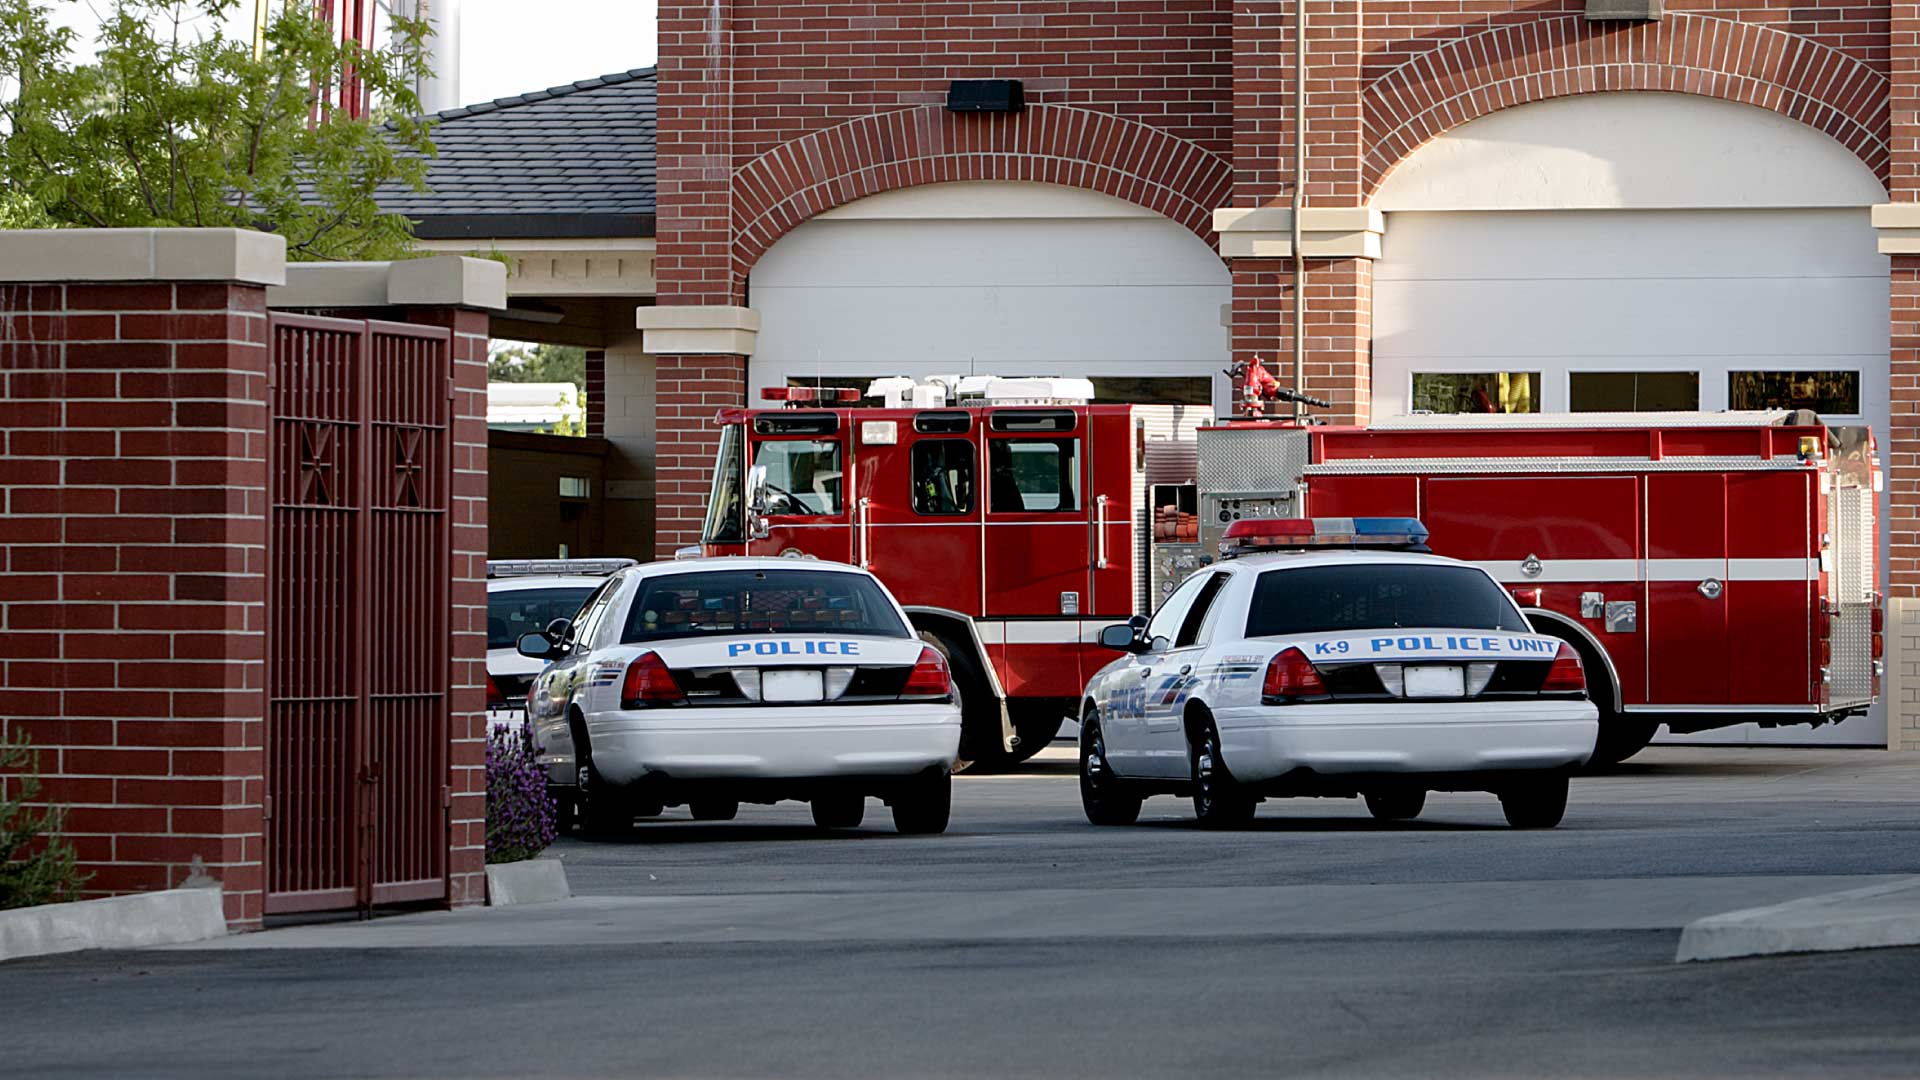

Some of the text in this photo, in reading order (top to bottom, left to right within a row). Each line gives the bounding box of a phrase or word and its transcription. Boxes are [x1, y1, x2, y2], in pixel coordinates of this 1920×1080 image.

[728, 641, 860, 657] POLICE
[1315, 637, 1554, 654] K-9 POLICE UNIT
[1109, 687, 1146, 718] POLICE
